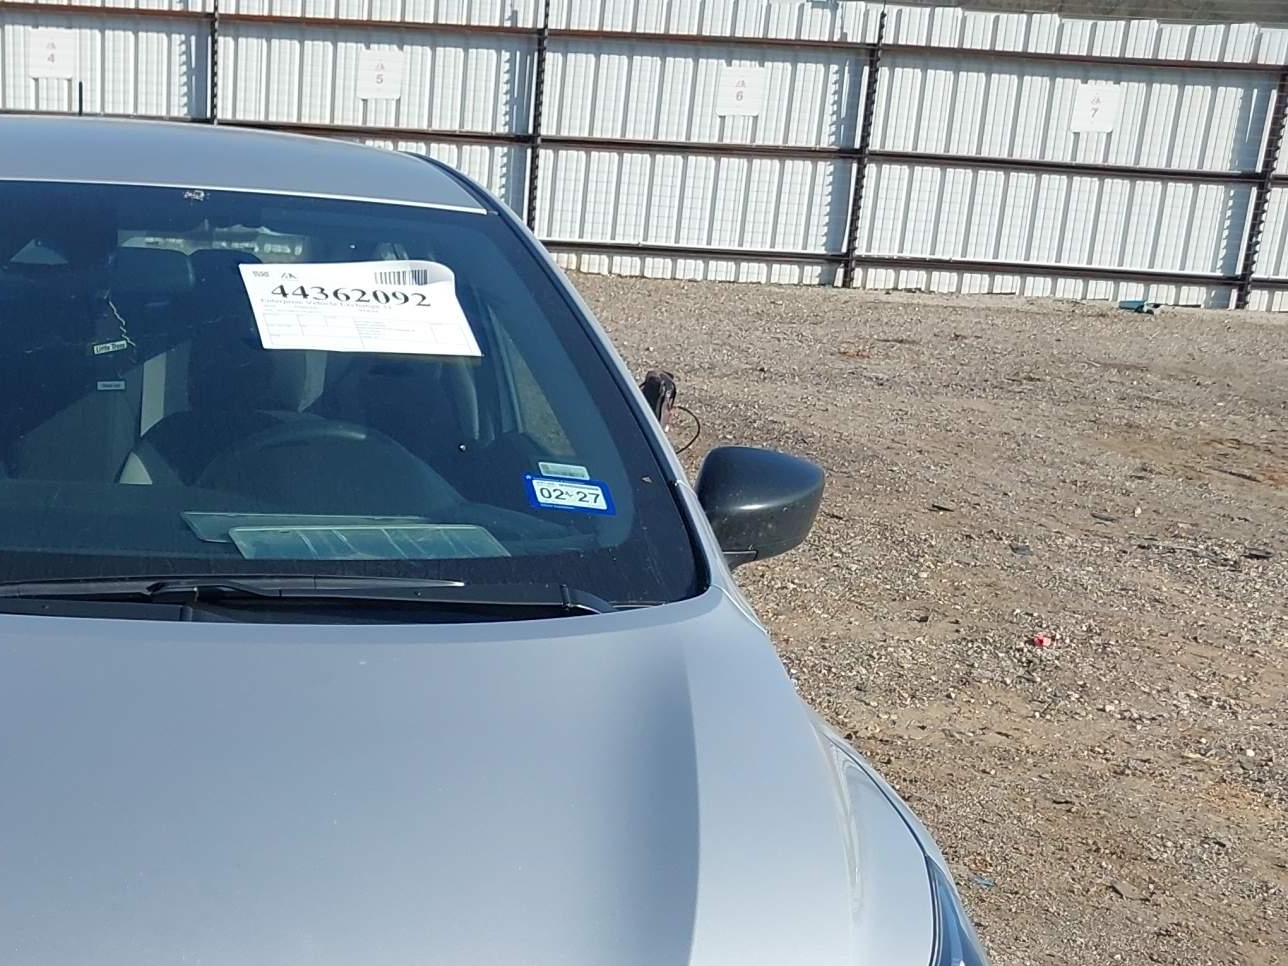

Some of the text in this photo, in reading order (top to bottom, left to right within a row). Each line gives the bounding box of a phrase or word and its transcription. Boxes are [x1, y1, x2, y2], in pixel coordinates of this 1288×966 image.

[271, 283, 431, 308] 44362092
[539, 487, 601, 504] 02 27
